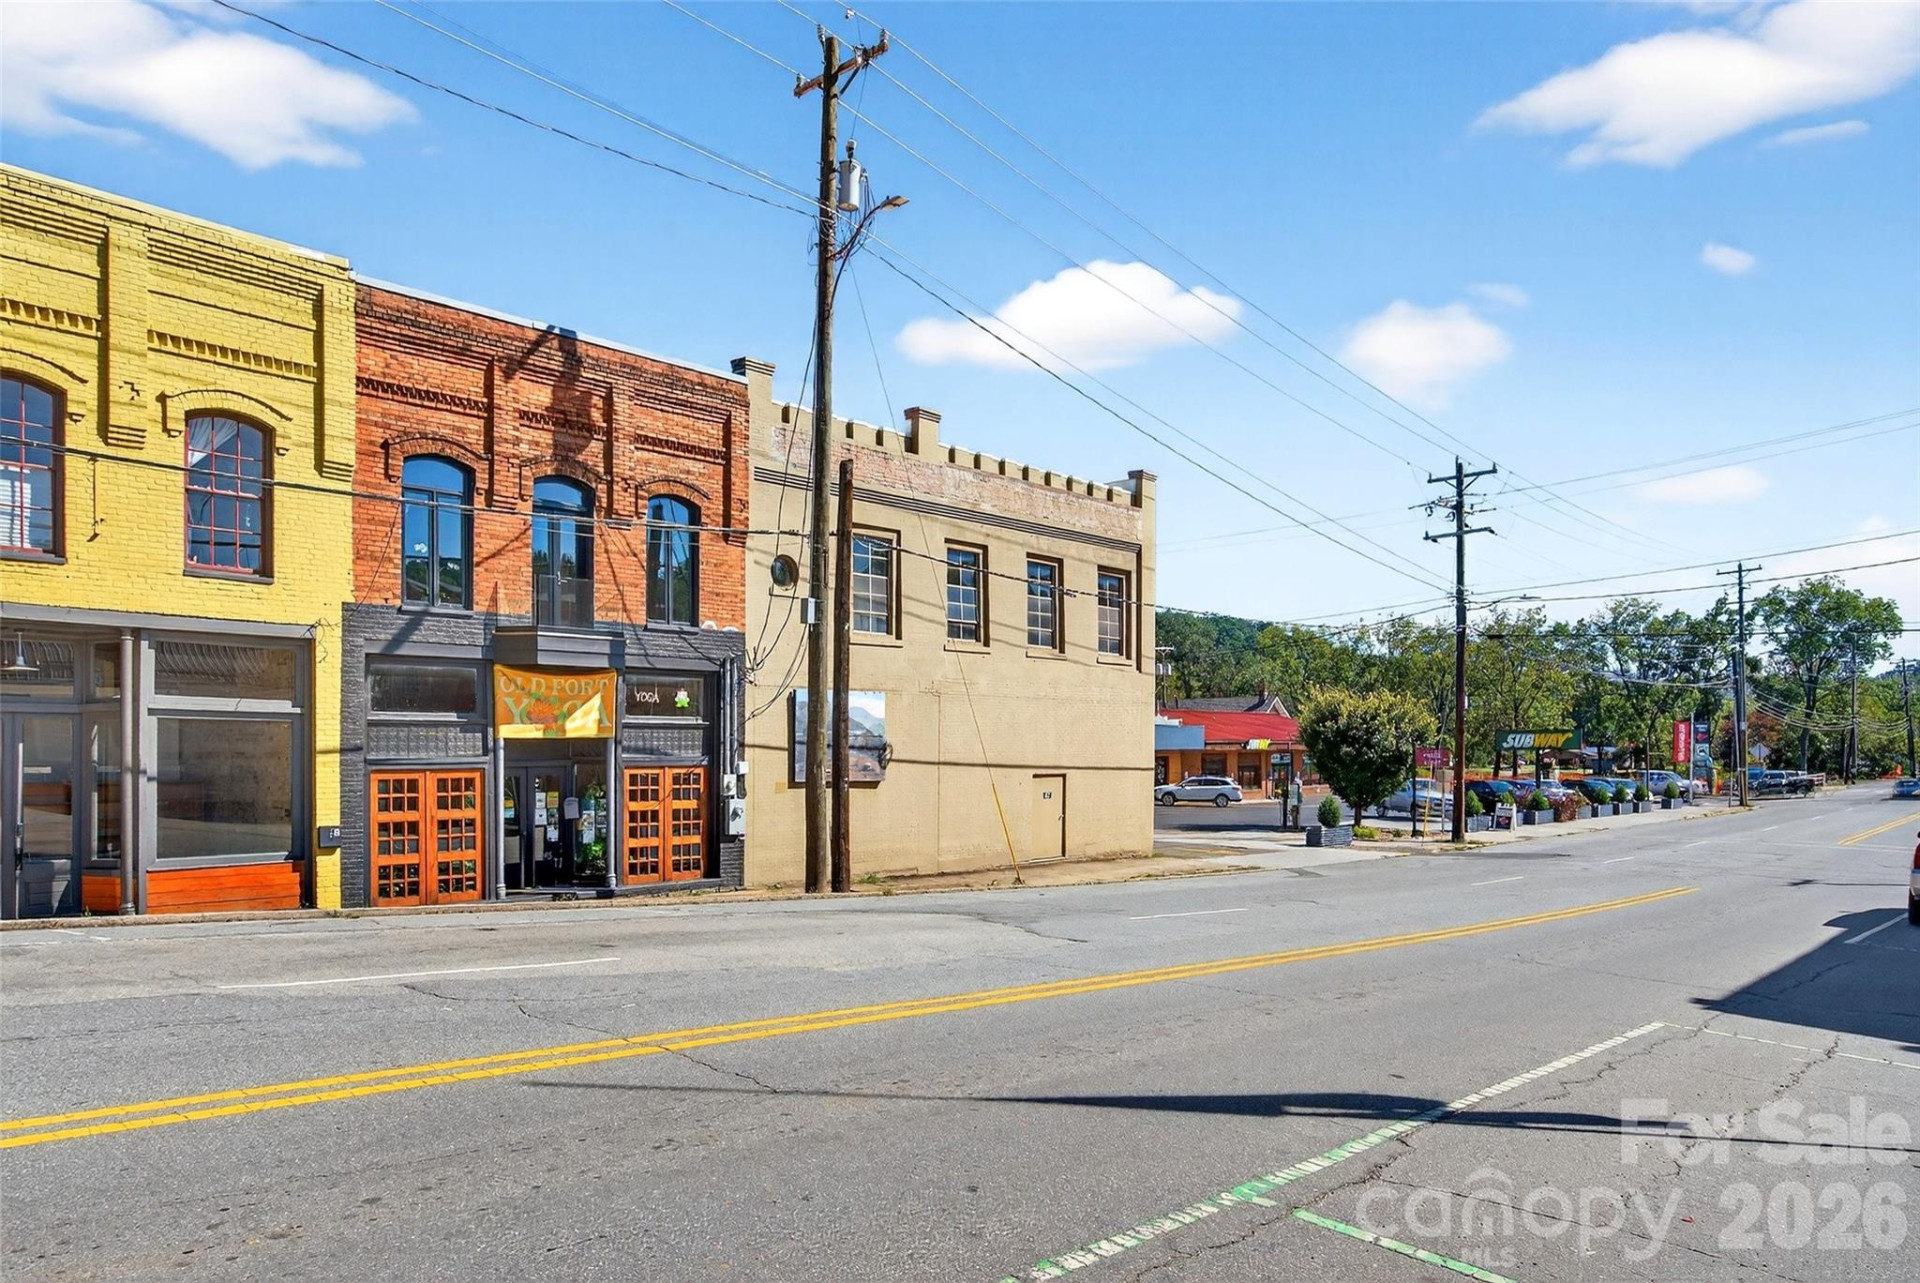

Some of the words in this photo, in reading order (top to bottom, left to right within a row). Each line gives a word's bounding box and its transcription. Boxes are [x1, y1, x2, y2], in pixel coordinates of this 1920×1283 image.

[500, 675, 547, 695] OLD
[551, 677, 610, 696] FORT
[1502, 732, 1573, 748] SUBWAY
